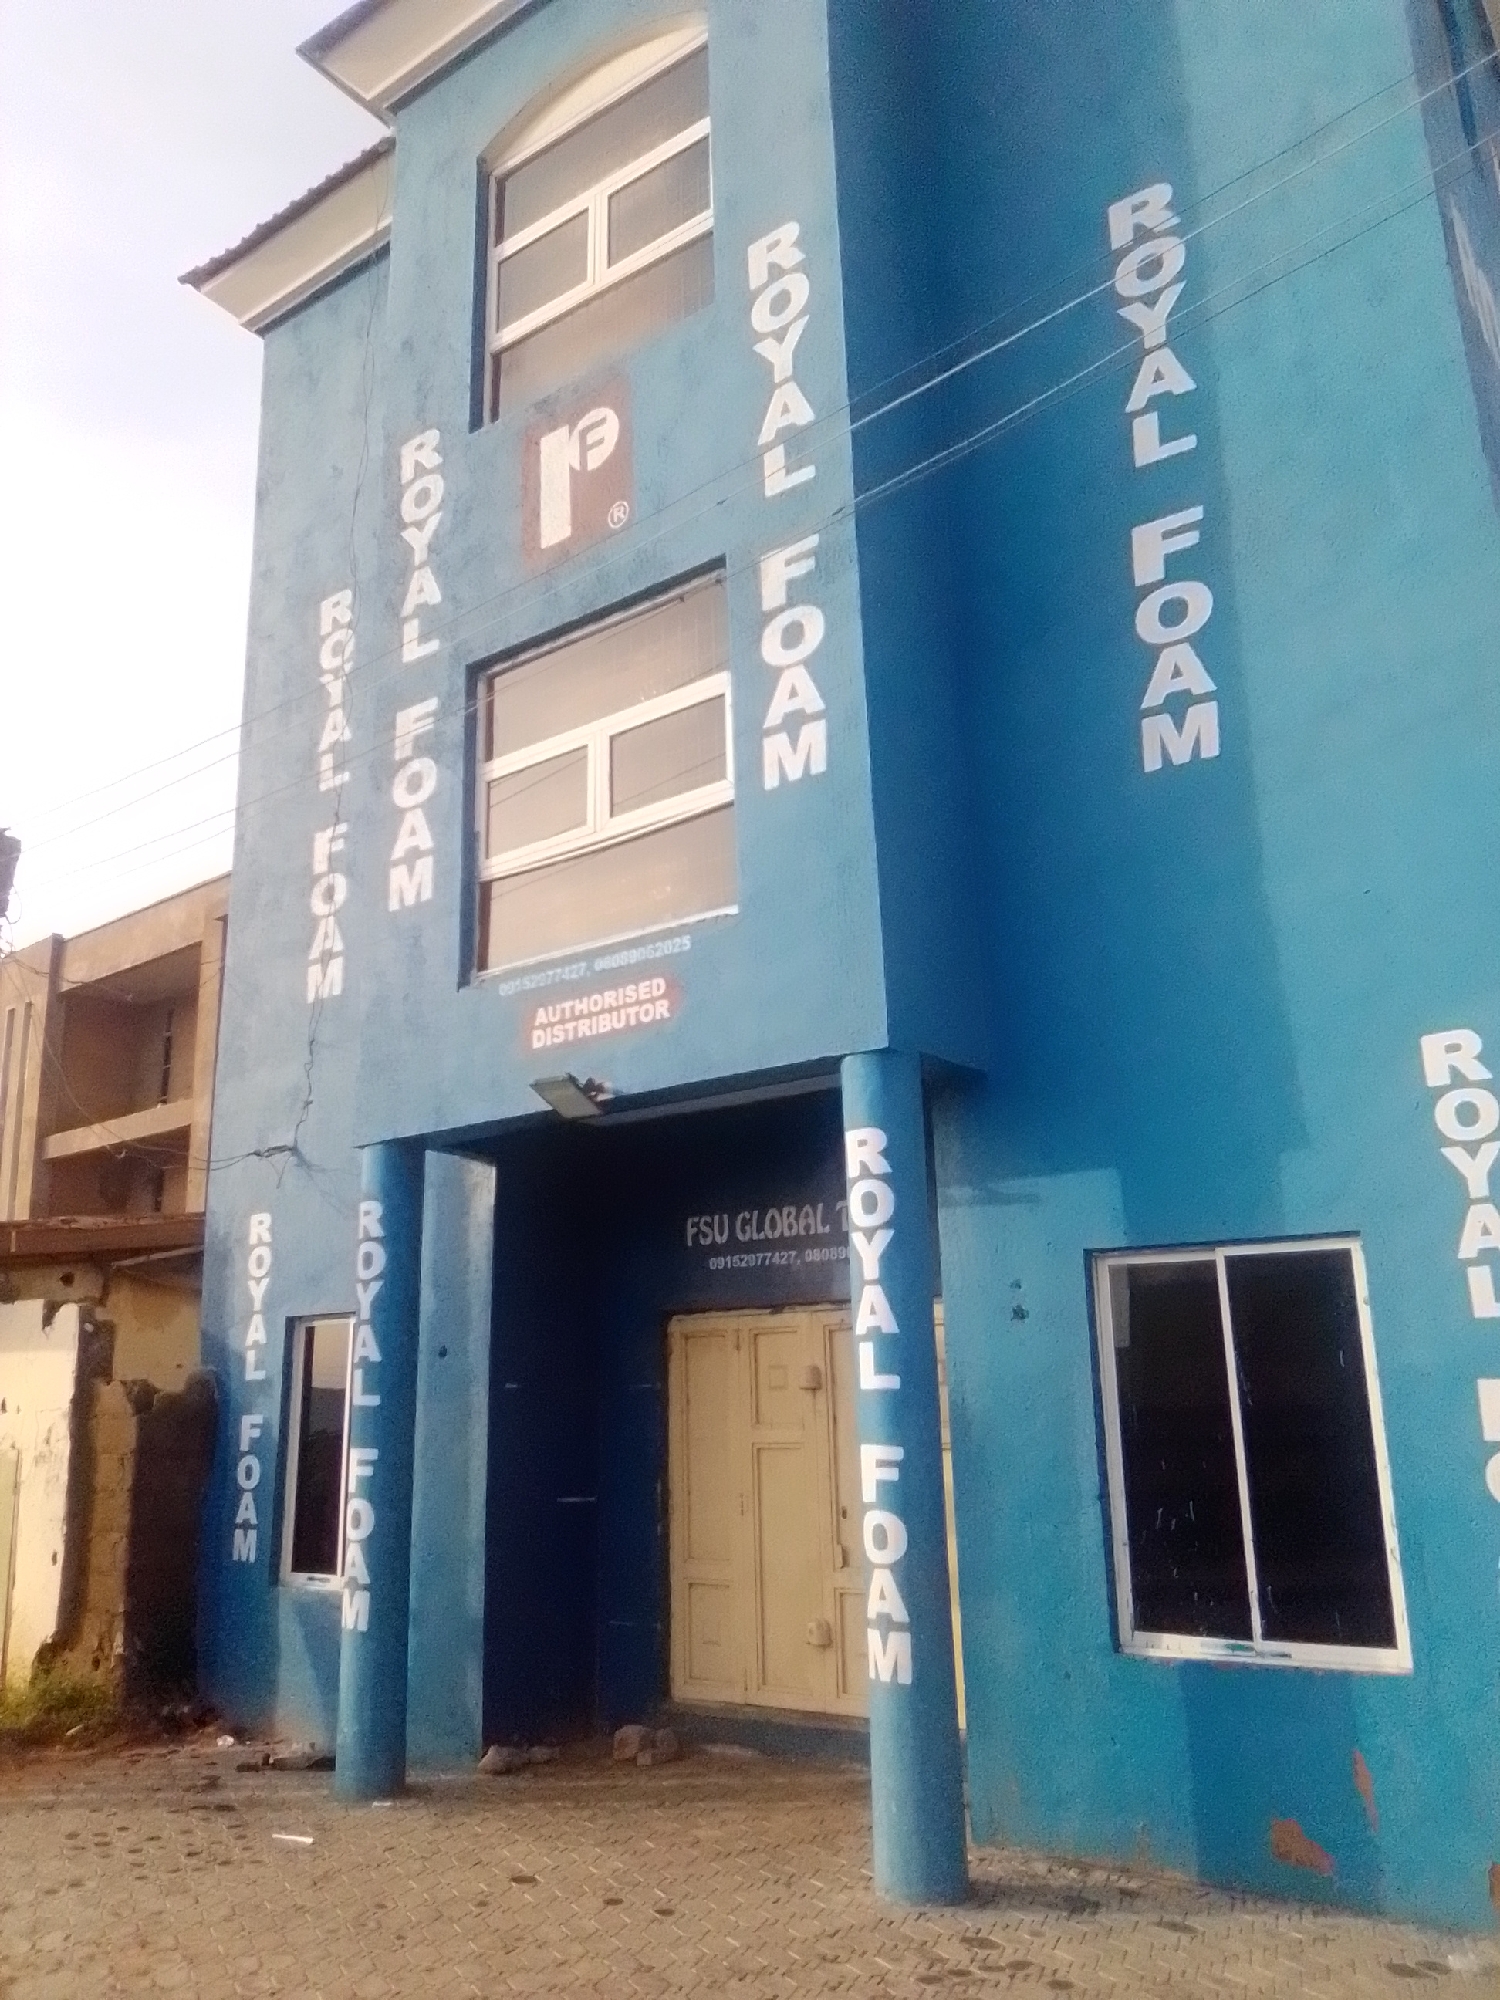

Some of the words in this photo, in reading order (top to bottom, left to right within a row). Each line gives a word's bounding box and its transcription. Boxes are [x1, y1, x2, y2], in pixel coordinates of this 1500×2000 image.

[747, 220, 815, 498] ROYAL
[1107, 181, 1197, 468] ROYAL
[400, 428, 444, 663] ROYAL
[1131, 505, 1221, 773] FOAM
[318, 589, 355, 792] ROYAL
[760, 533, 827, 791] FOAM
[389, 697, 438, 912] FOAM
[307, 822, 347, 1004] FOAM
[534, 977, 666, 1027] AUTHORISED
[531, 999, 671, 1050] DISTRIBUTOR
[687, 1214, 729, 1246] FSU
[735, 1203, 830, 1242] GLOBAL
[845, 1127, 900, 1391] ROYAL
[1420, 1028, 1500, 1318] ROYAL
[244, 1212, 272, 1381] ROYAL
[352, 1200, 386, 1406] ROYAL
[232, 1415, 261, 1563] FOAM
[342, 1447, 379, 1632] FOAM
[860, 1443, 912, 1685] FOAM
